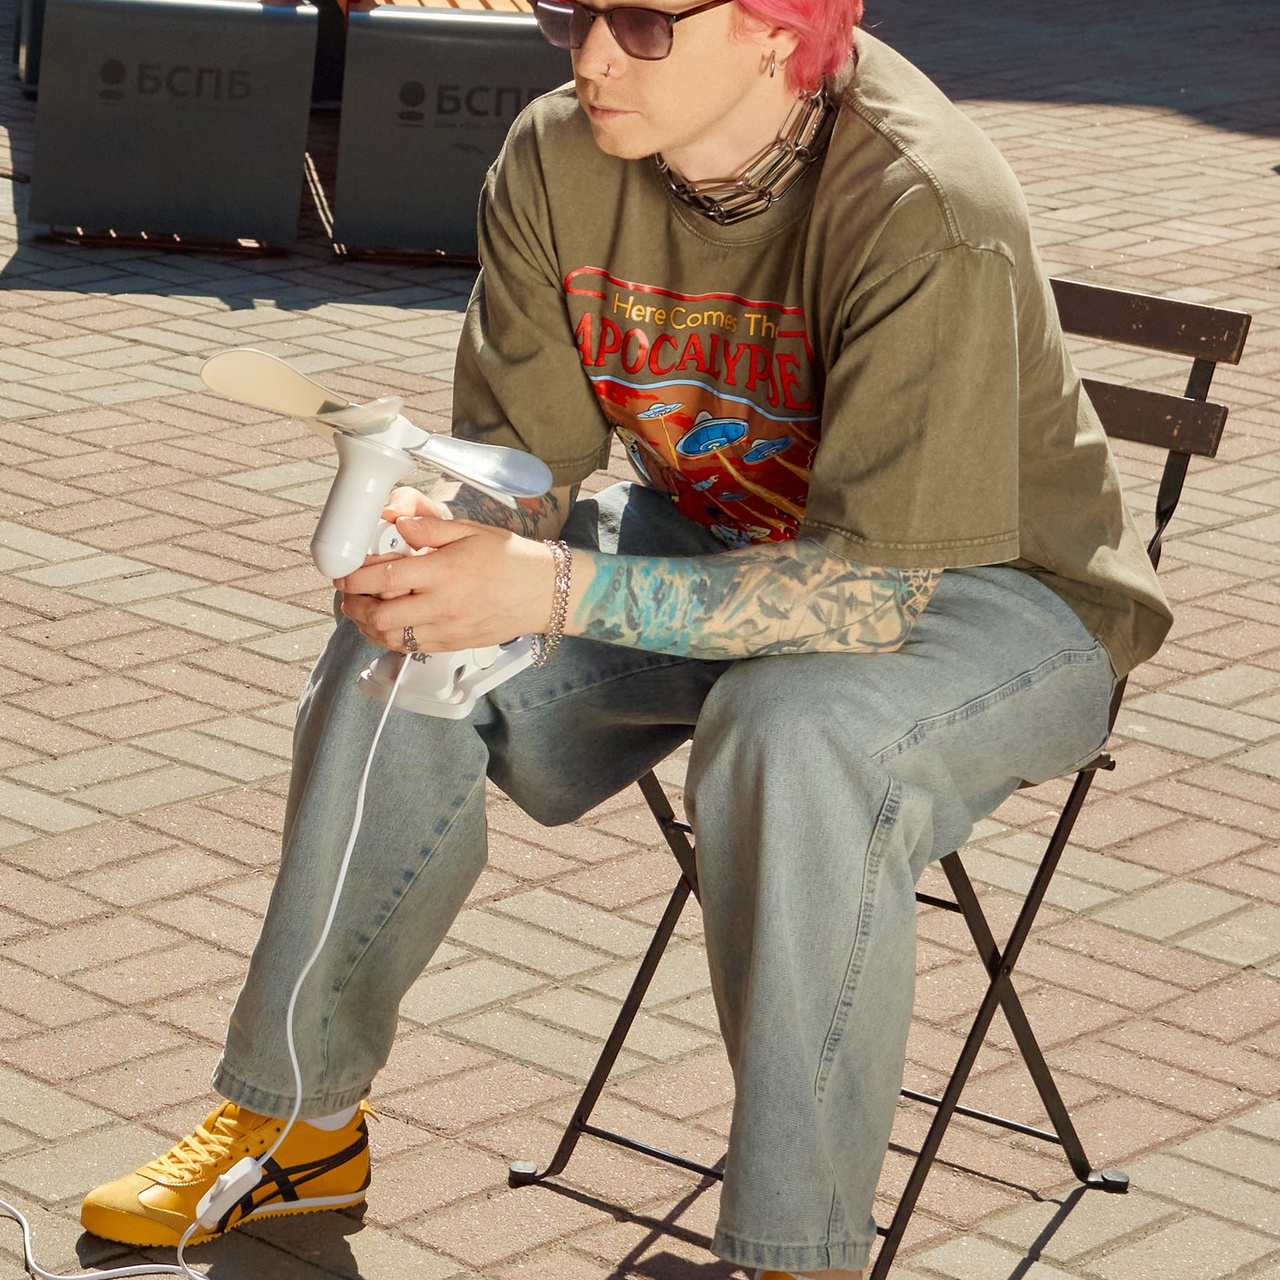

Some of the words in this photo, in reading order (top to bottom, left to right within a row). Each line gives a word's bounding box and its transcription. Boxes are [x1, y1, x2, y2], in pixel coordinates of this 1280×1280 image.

[138, 63, 252, 100] БСПБ
[613, 293, 667, 326] Here
[670, 307, 738, 334] Comes
